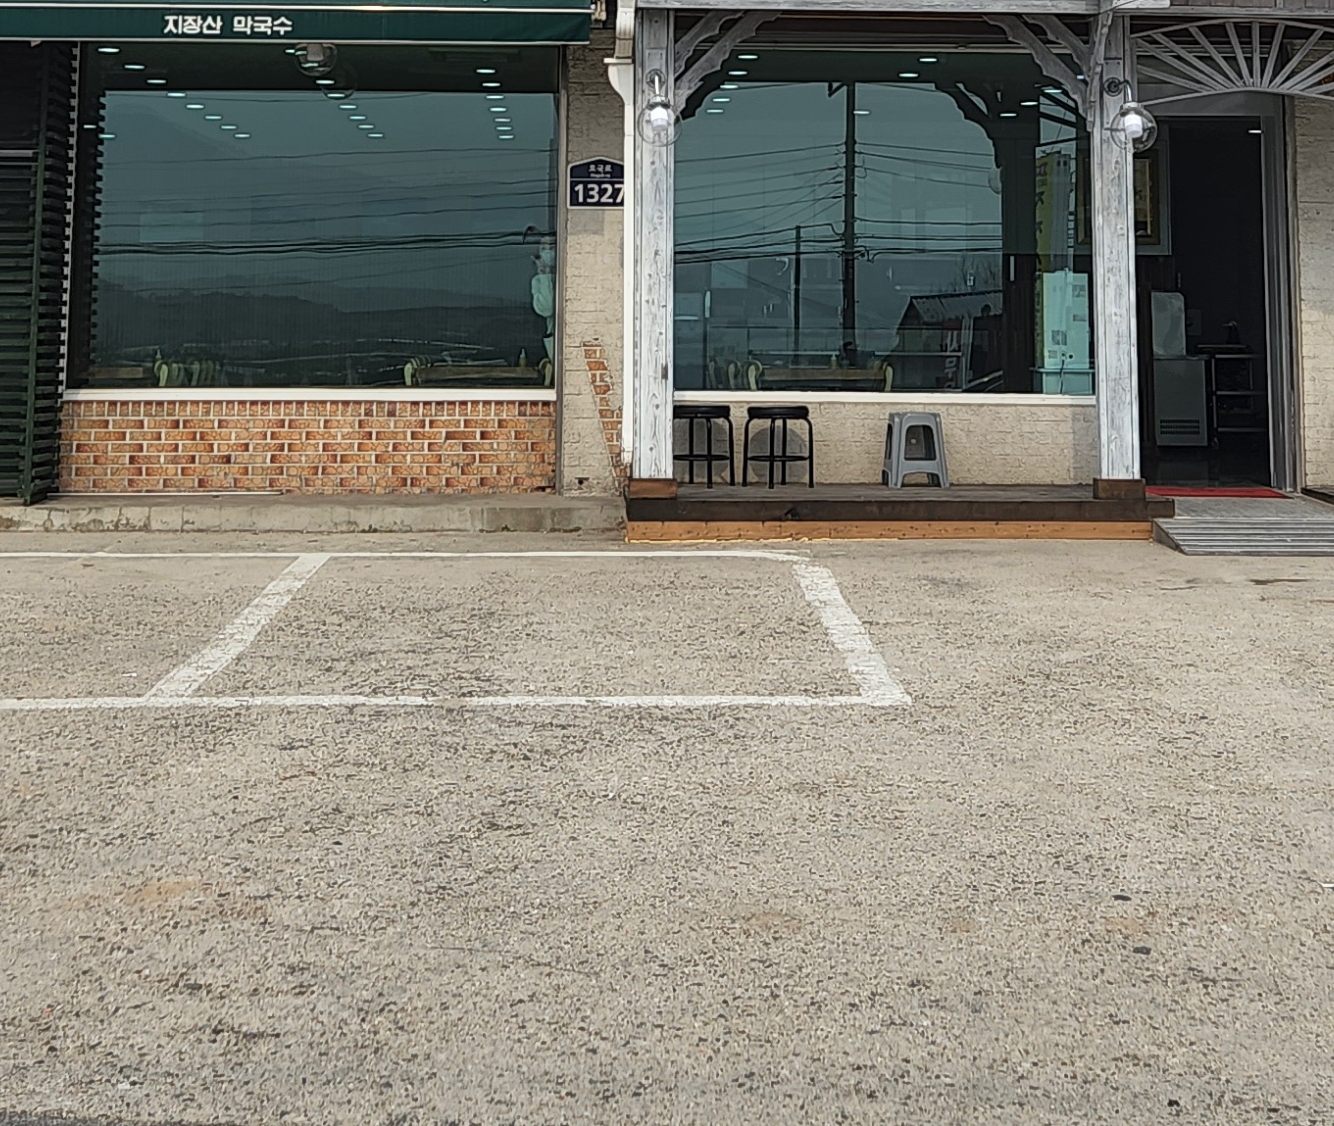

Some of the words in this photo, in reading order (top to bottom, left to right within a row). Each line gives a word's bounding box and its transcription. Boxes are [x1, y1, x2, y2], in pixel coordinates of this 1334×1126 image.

[163, 15, 223, 34] 지장산
[233, 16, 293, 35] 막국수
[574, 183, 624, 203] 1327
